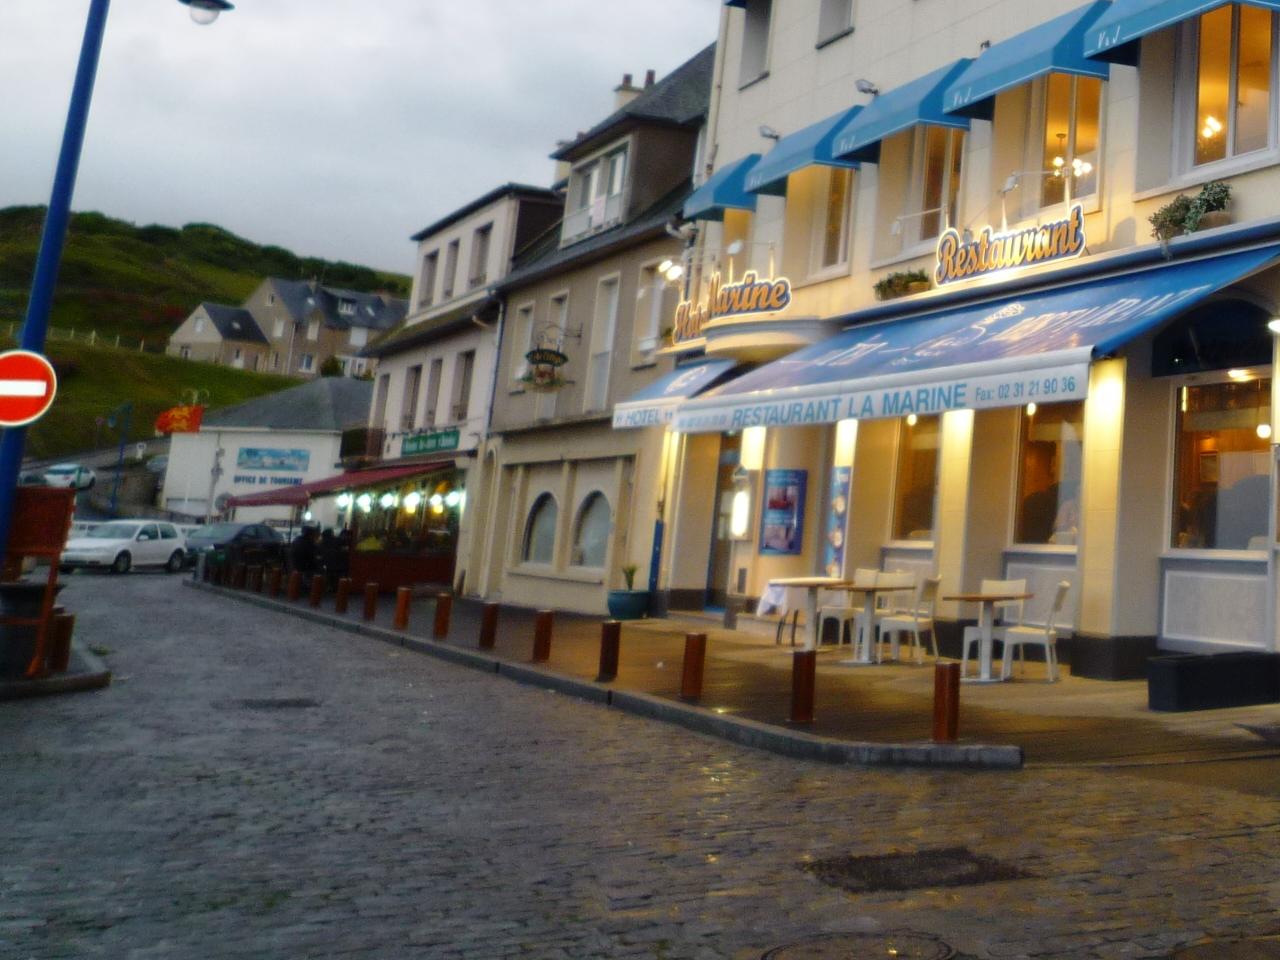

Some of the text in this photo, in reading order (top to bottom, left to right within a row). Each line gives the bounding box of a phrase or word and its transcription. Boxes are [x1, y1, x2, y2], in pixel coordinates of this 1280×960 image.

[935, 206, 1082, 284] Restaurant
[627, 407, 661, 426] HOTEL
[731, 398, 842, 427] RESTAURANT
[848, 397, 873, 418] LA
[882, 383, 967, 415] MARINE
[998, 384, 1009, 400] 02
[1013, 382, 1024, 397] 31
[1028, 380, 1040, 396] 21
[1044, 378, 1057, 395] 90
[1061, 376, 1075, 393] 36
